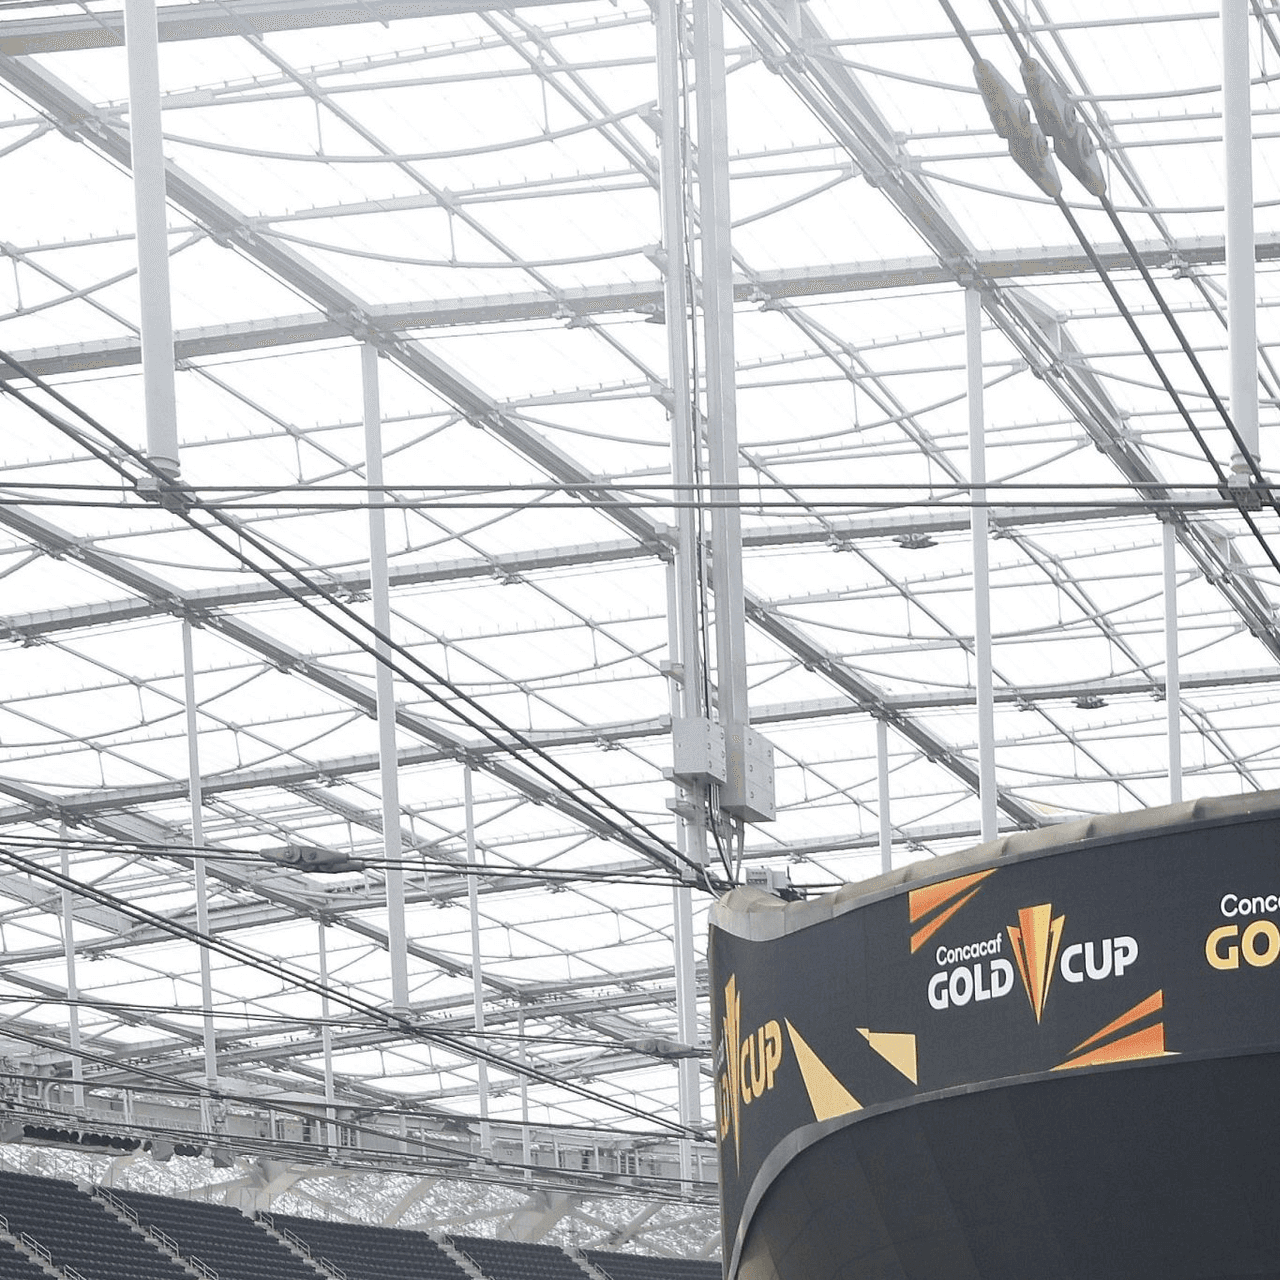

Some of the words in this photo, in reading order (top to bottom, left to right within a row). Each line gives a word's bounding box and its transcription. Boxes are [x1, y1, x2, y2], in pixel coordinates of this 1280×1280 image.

[928, 958, 1014, 1010] GOLD
[1061, 935, 1139, 983] CUP
[936, 932, 1003, 963] Concacaf
[741, 1020, 782, 1105] CUP
